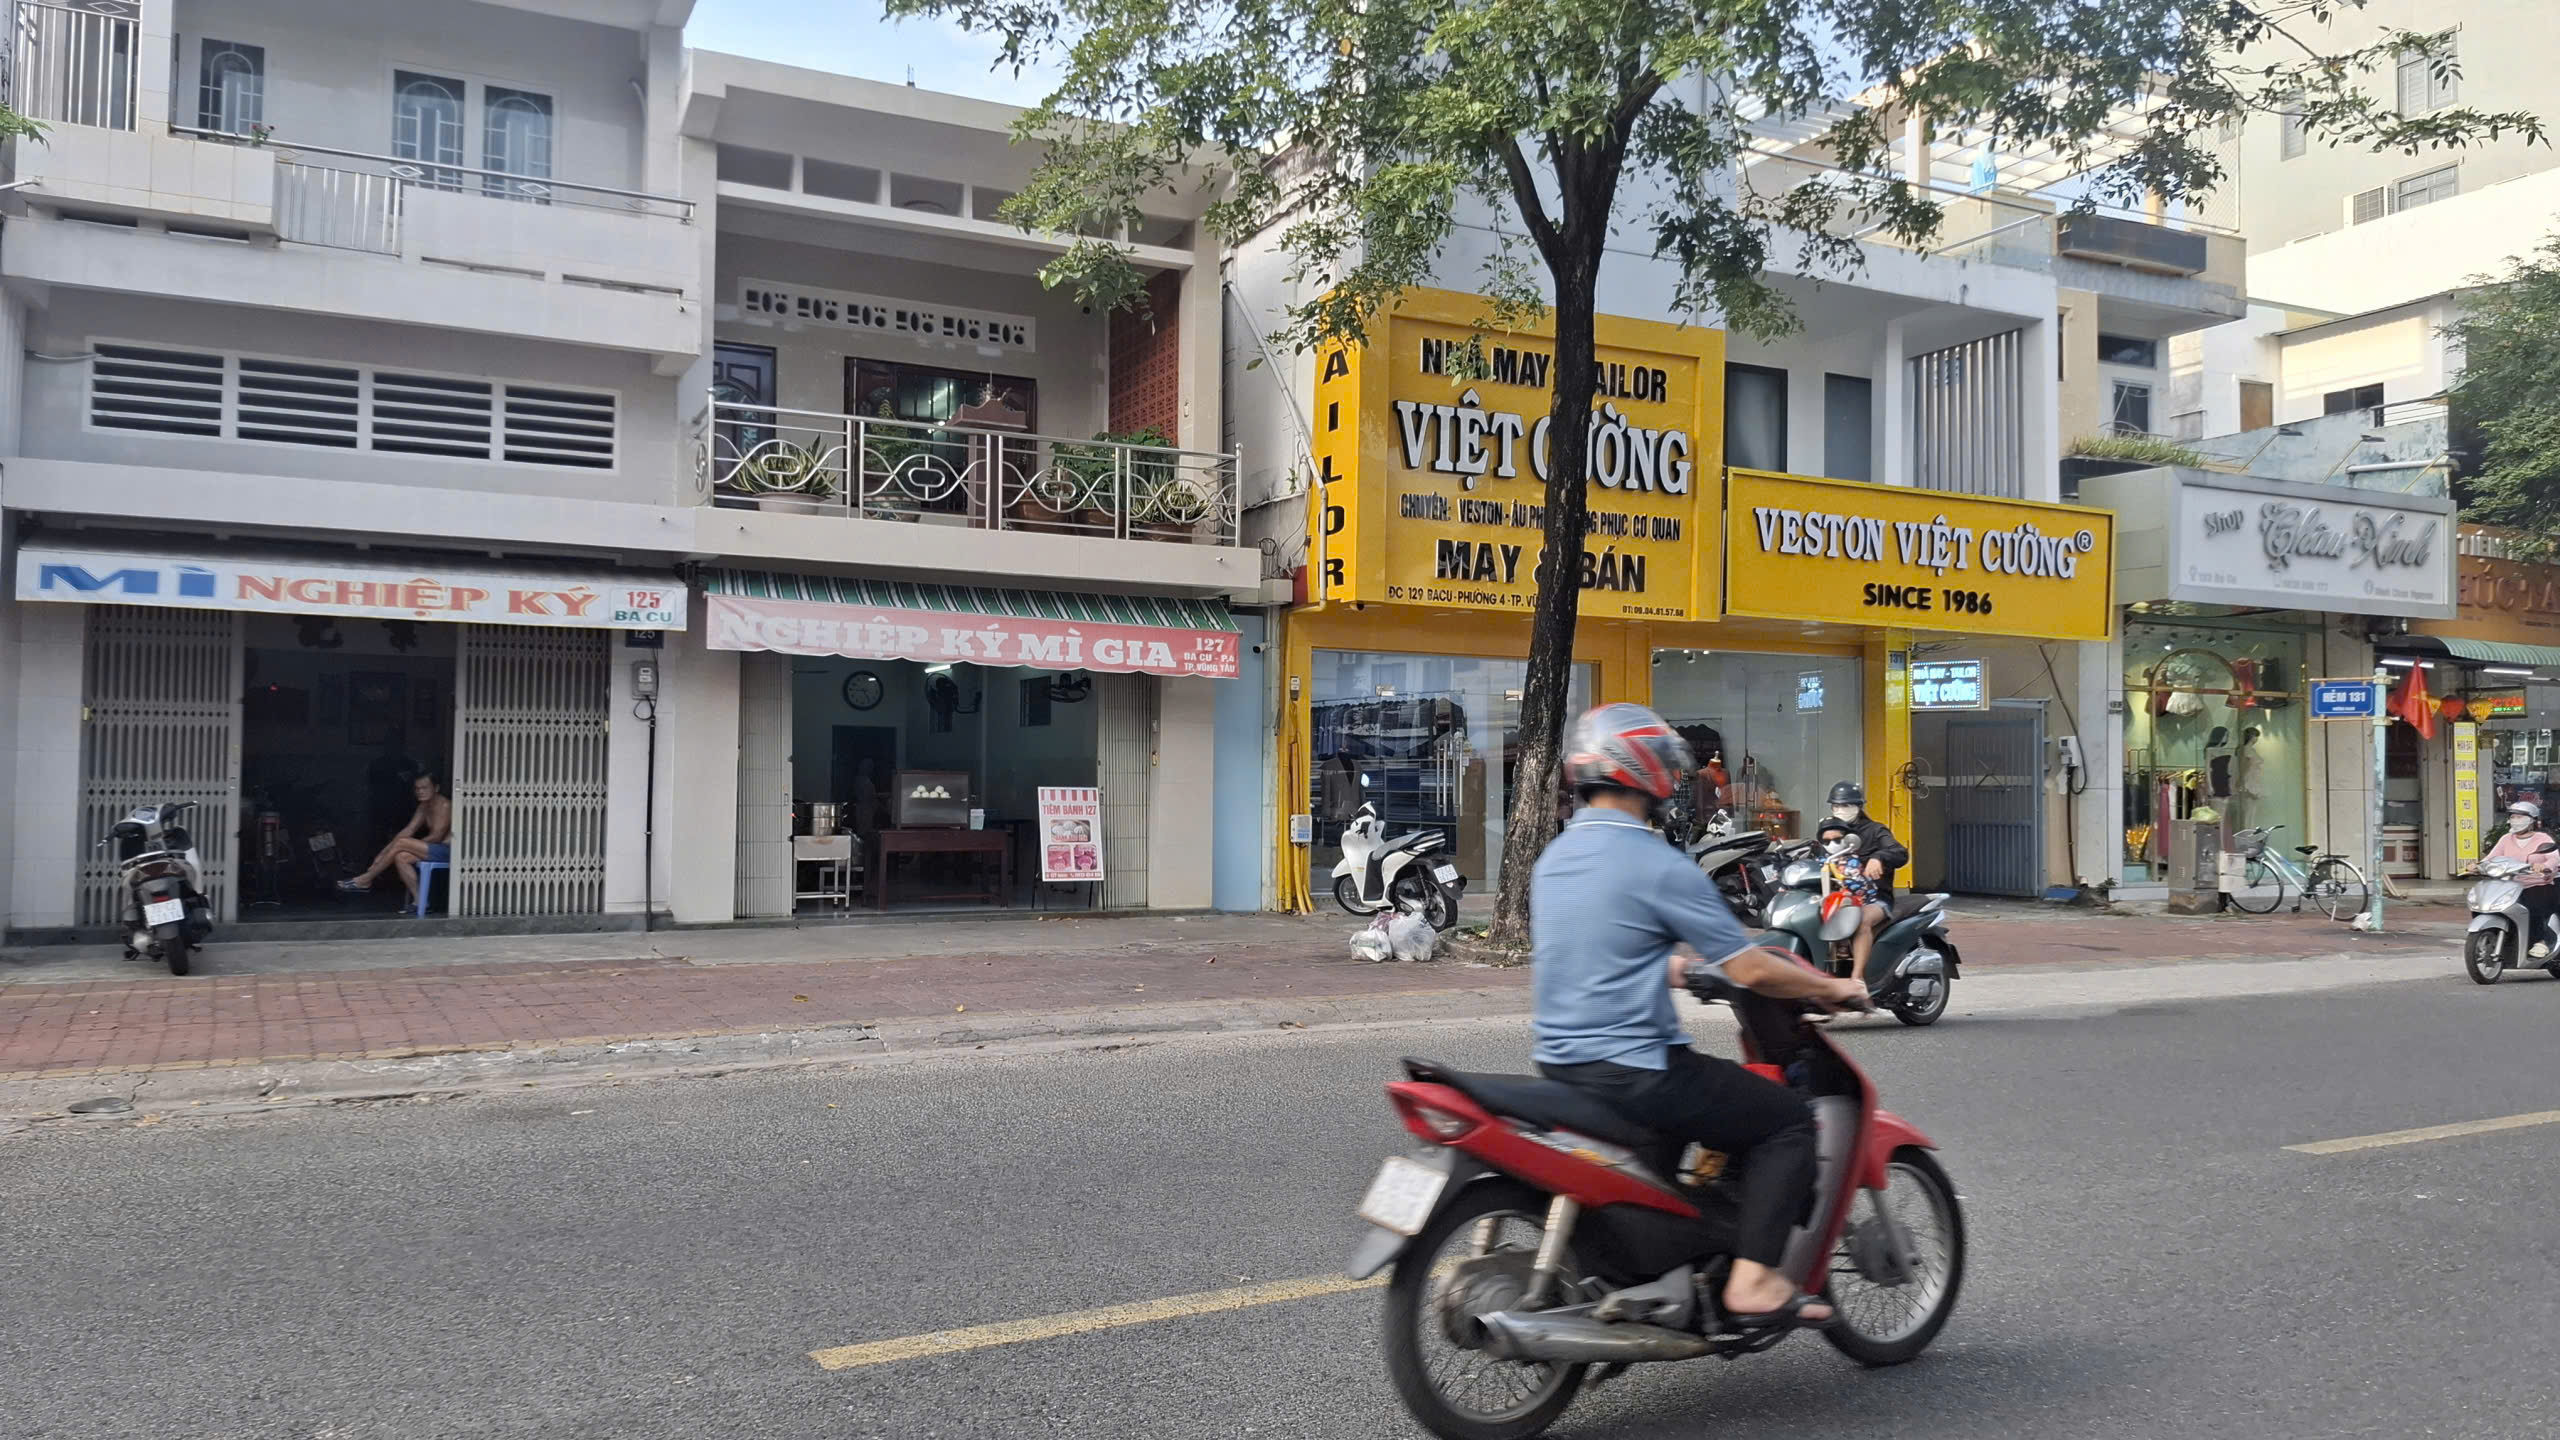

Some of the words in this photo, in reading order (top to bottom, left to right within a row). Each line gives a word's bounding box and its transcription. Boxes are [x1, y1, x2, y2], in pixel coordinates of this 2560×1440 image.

[1491, 347, 1551, 388] MAY
[1595, 360, 1668, 403] AILOR
[1393, 387, 1525, 491] VIỆT
[1457, 498, 1503, 526] VESTON
[1598, 511, 1628, 541] PHỤC
[1632, 513, 1647, 538] CƠ
[1651, 516, 1681, 542] QUAN
[2203, 508, 2245, 537] Shop
[1752, 506, 1886, 561] VESTON
[1894, 514, 1973, 577] VIỆT
[1434, 538, 1522, 584] MAY
[39, 562, 216, 598] MÌ
[237, 575, 490, 618] NGHIỆP
[506, 585, 600, 617] KÝ
[627, 591, 662, 609] 125
[1408, 587, 1424, 601] 129
[1862, 583, 1932, 610] SINCE
[1943, 589, 1992, 614] 1986
[615, 610, 641, 622] BA
[646, 611, 672, 623] CU
[719, 613, 929, 658] NGHIỆP
[940, 623, 1009, 659] KÝ
[1018, 627, 1083, 664] MÌ
[1093, 637, 1177, 668] GIA
[1195, 637, 1225, 652] 127
[2348, 691, 2366, 703] 131
